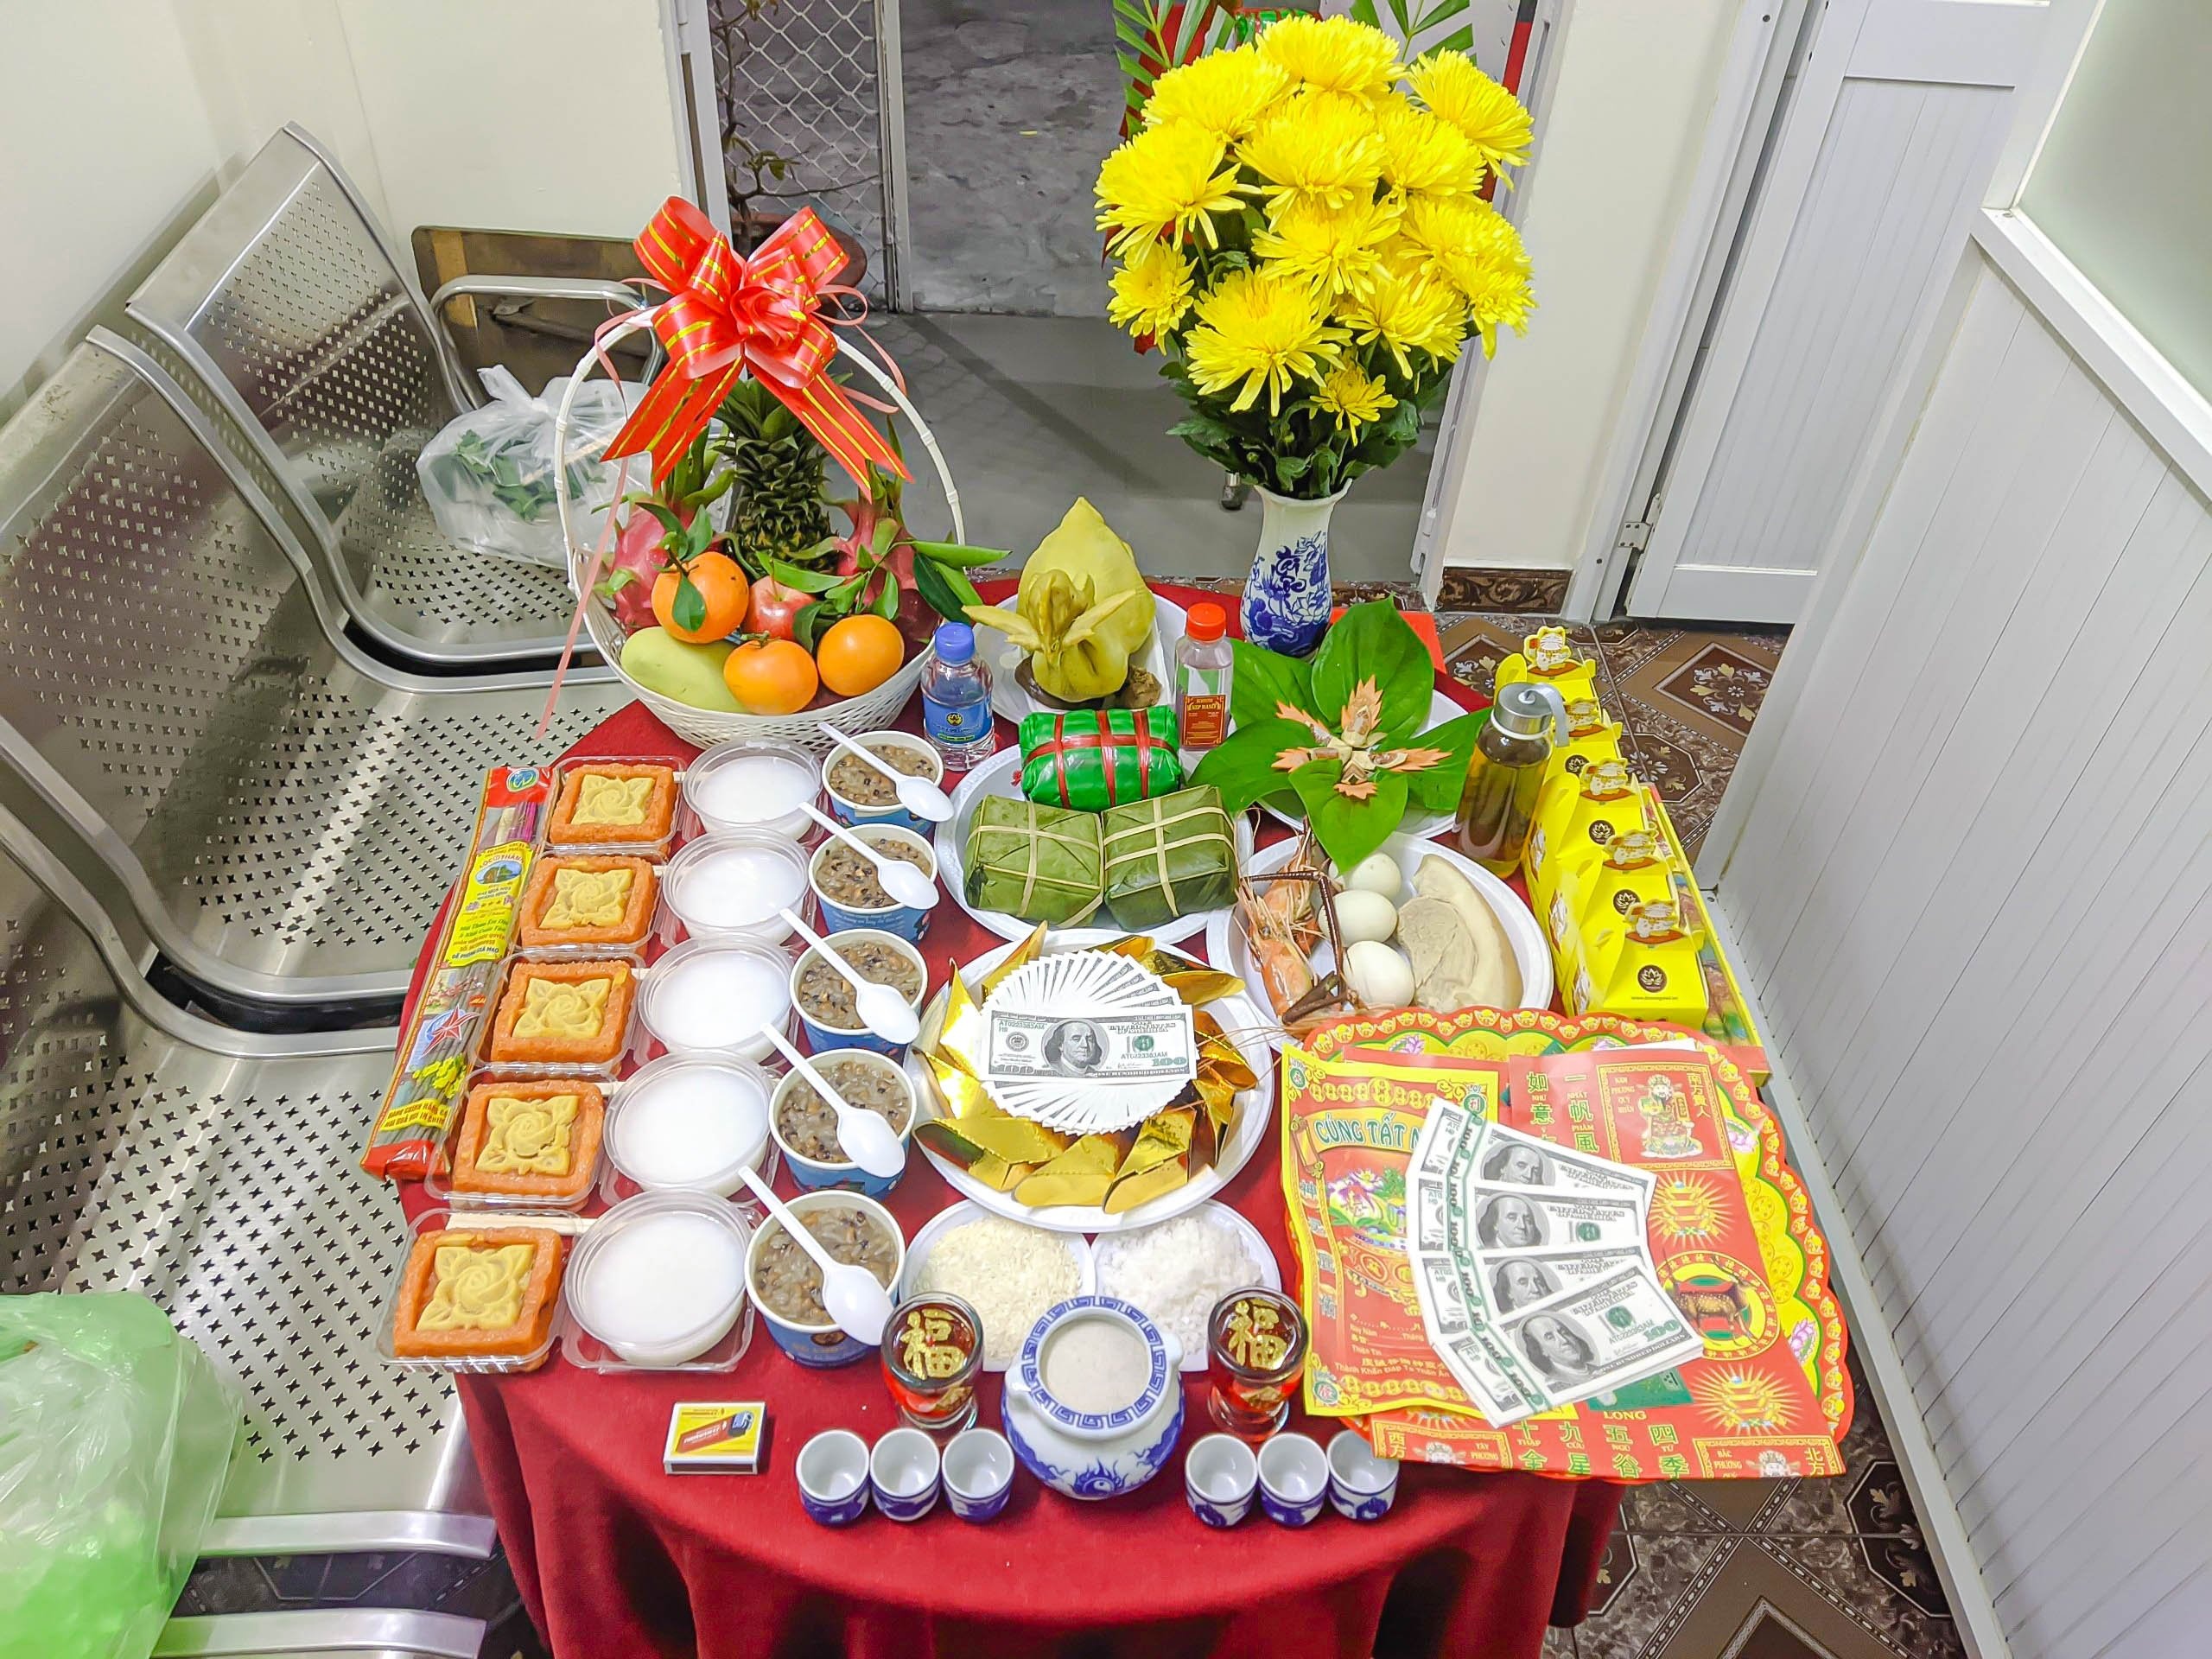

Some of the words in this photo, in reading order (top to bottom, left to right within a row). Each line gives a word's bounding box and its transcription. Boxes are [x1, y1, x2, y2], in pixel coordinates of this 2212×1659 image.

[1152, 1057, 1187, 1067] 100
[1527, 1071, 1548, 1094] 如
[1530, 1103, 1554, 1125] 意
[1569, 1099, 1594, 1122] 帆
[1313, 1112, 1365, 1144] CÚNG
[1366, 1112, 1408, 1149] TẤT
[1576, 1133, 1599, 1153] 風
[900, 1308, 966, 1380] 福
[1229, 1298, 1287, 1370] 福
[1334, 1362, 1360, 1374] Thành
[1389, 1431, 1407, 1459] 西方
[1804, 1447, 1825, 1476] 北方
